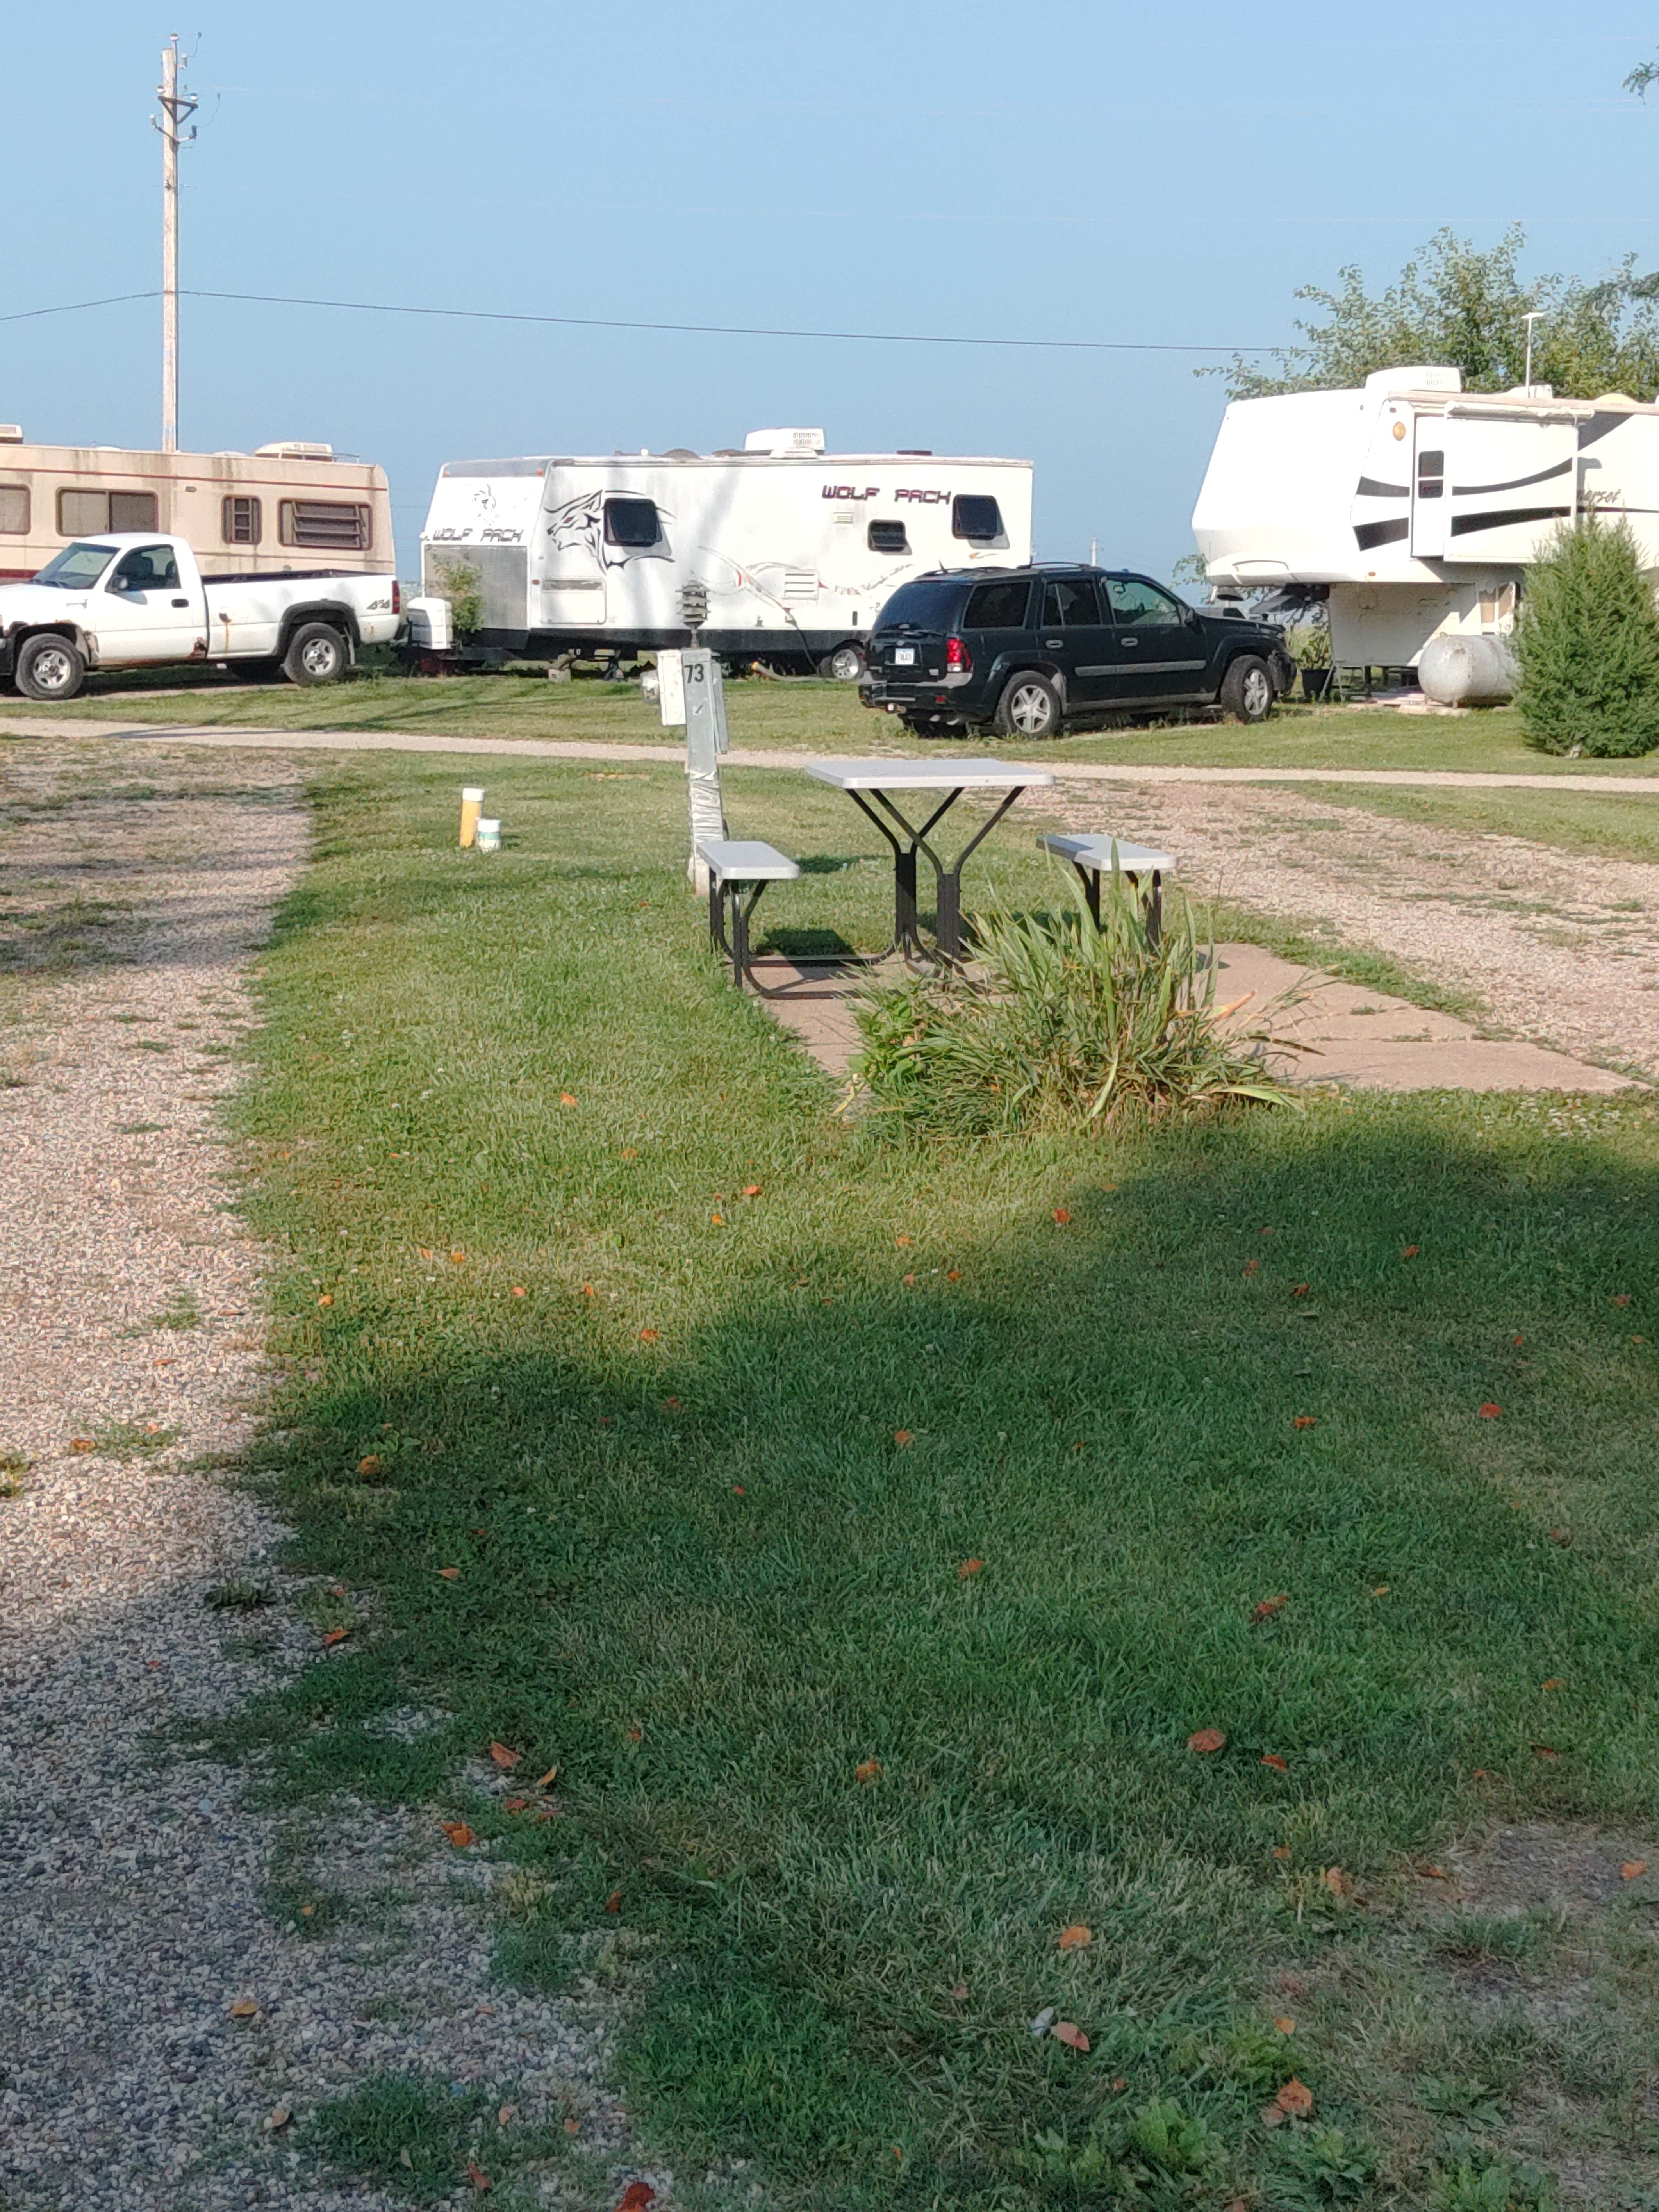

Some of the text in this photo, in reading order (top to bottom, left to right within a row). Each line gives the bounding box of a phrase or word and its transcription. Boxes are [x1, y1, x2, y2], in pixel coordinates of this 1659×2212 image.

[822, 485, 952, 505] WOLF PACK
[432, 528, 524, 542] WOLF PACK
[684, 664, 704, 684] 73
